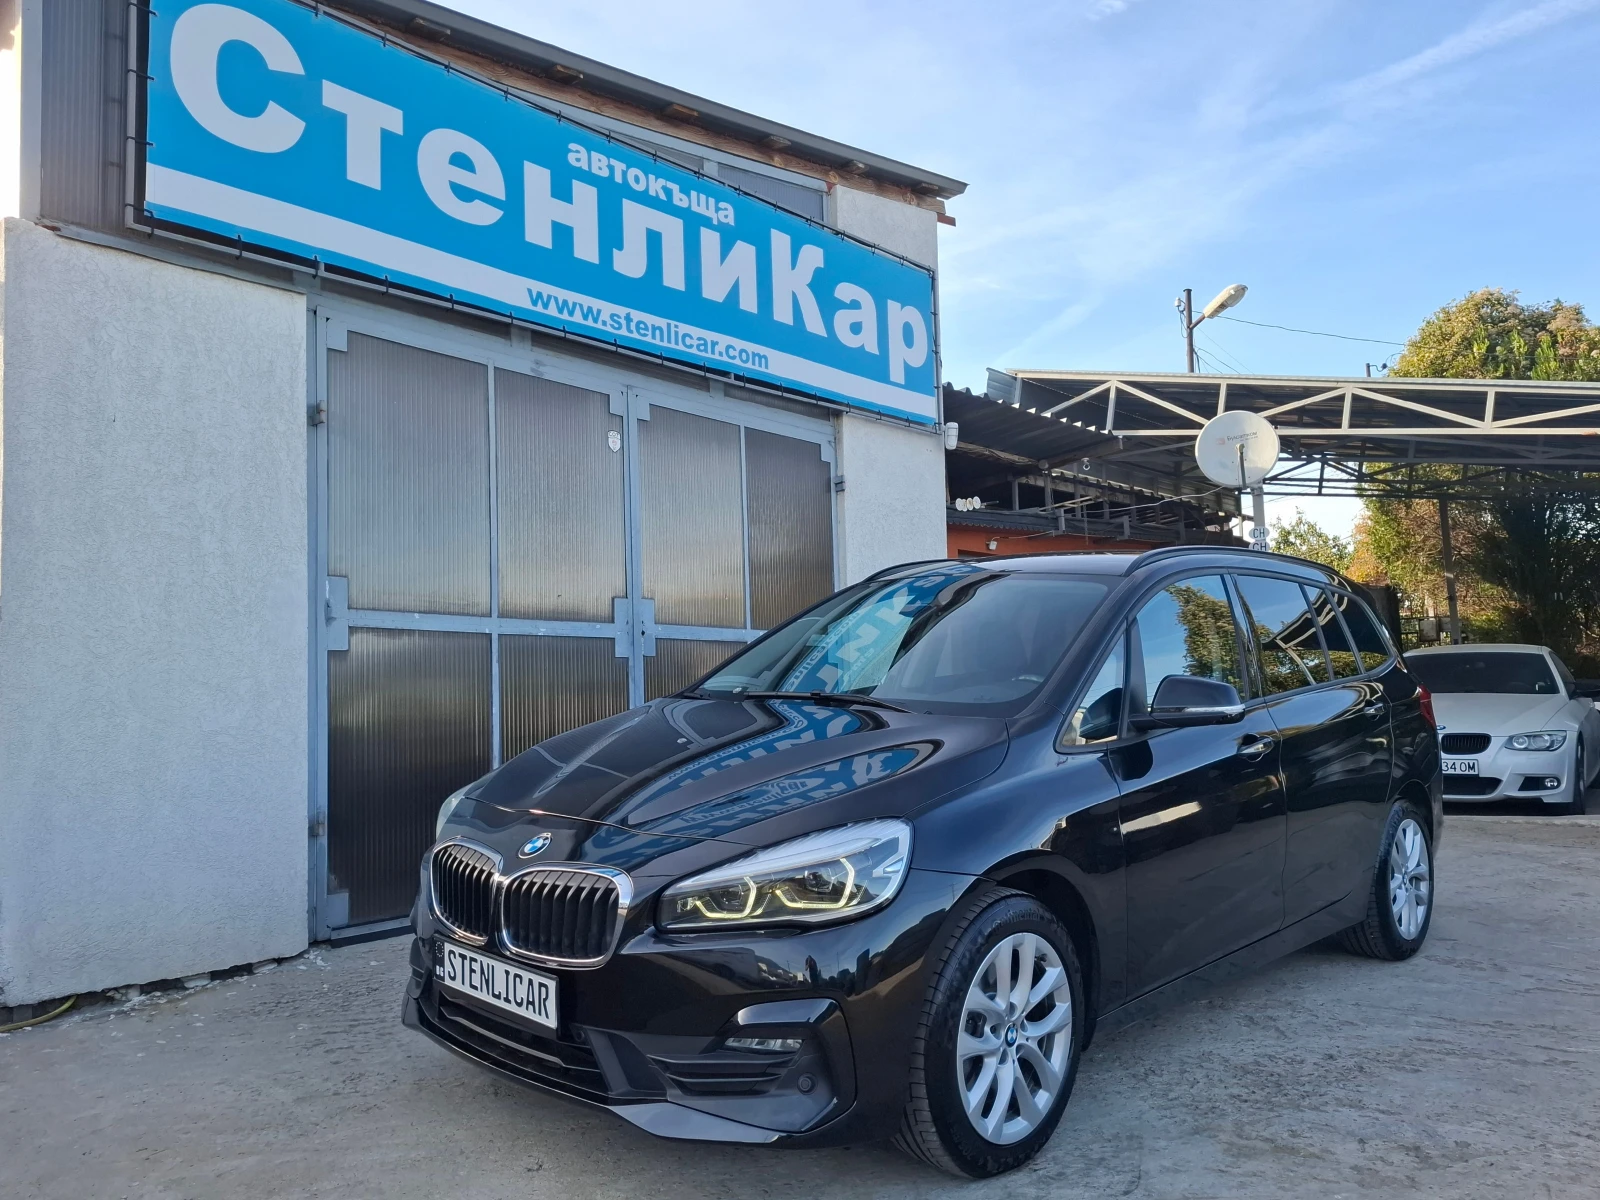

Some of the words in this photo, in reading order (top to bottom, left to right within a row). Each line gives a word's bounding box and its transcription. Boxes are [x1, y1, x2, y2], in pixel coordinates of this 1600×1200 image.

[170, 3, 928, 385] СтенлиКар
[567, 143, 735, 226] автокъща
[527, 288, 769, 370] www.stenlicar.com
[1253, 528, 1265, 538] CH
[448, 949, 549, 1019] STENLICAR
